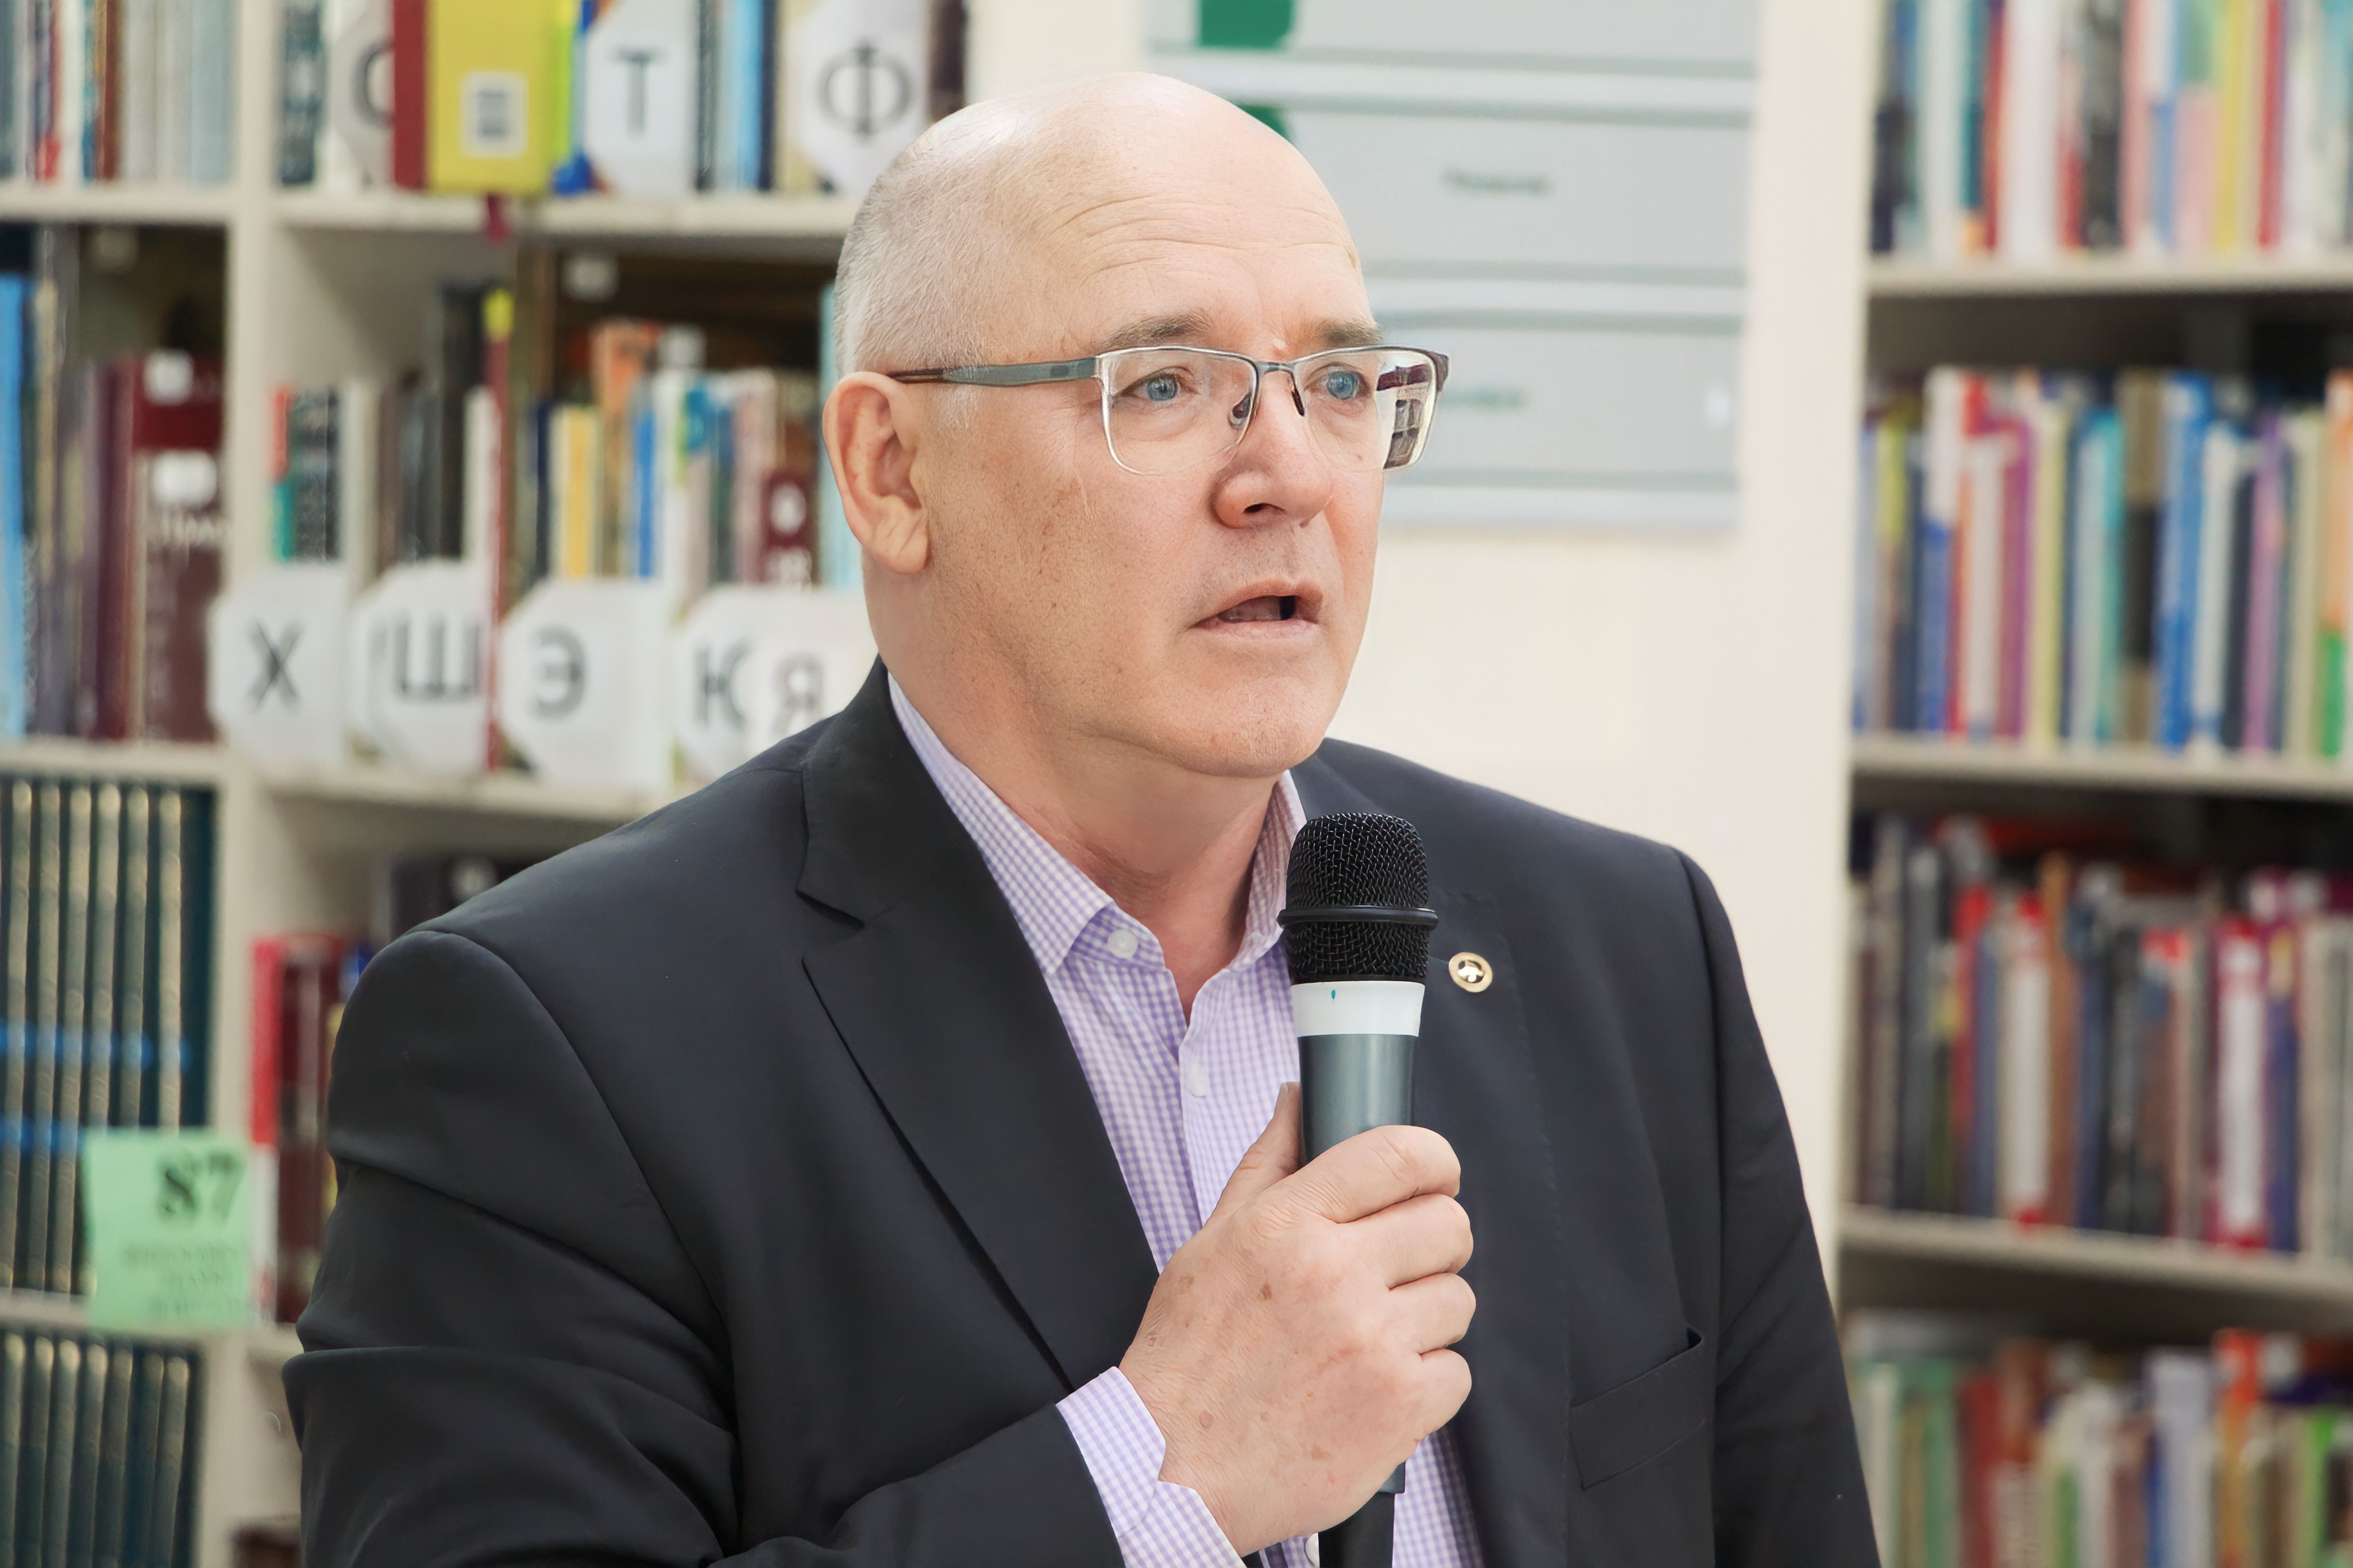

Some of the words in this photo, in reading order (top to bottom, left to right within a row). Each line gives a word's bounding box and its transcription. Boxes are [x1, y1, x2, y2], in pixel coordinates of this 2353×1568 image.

[615, 43, 668, 136] Т
[819, 39, 912, 141] Ф
[248, 619, 303, 715] Х
[394, 612, 481, 702] Ш
[530, 627, 587, 720] Э
[773, 651, 826, 736] Я
